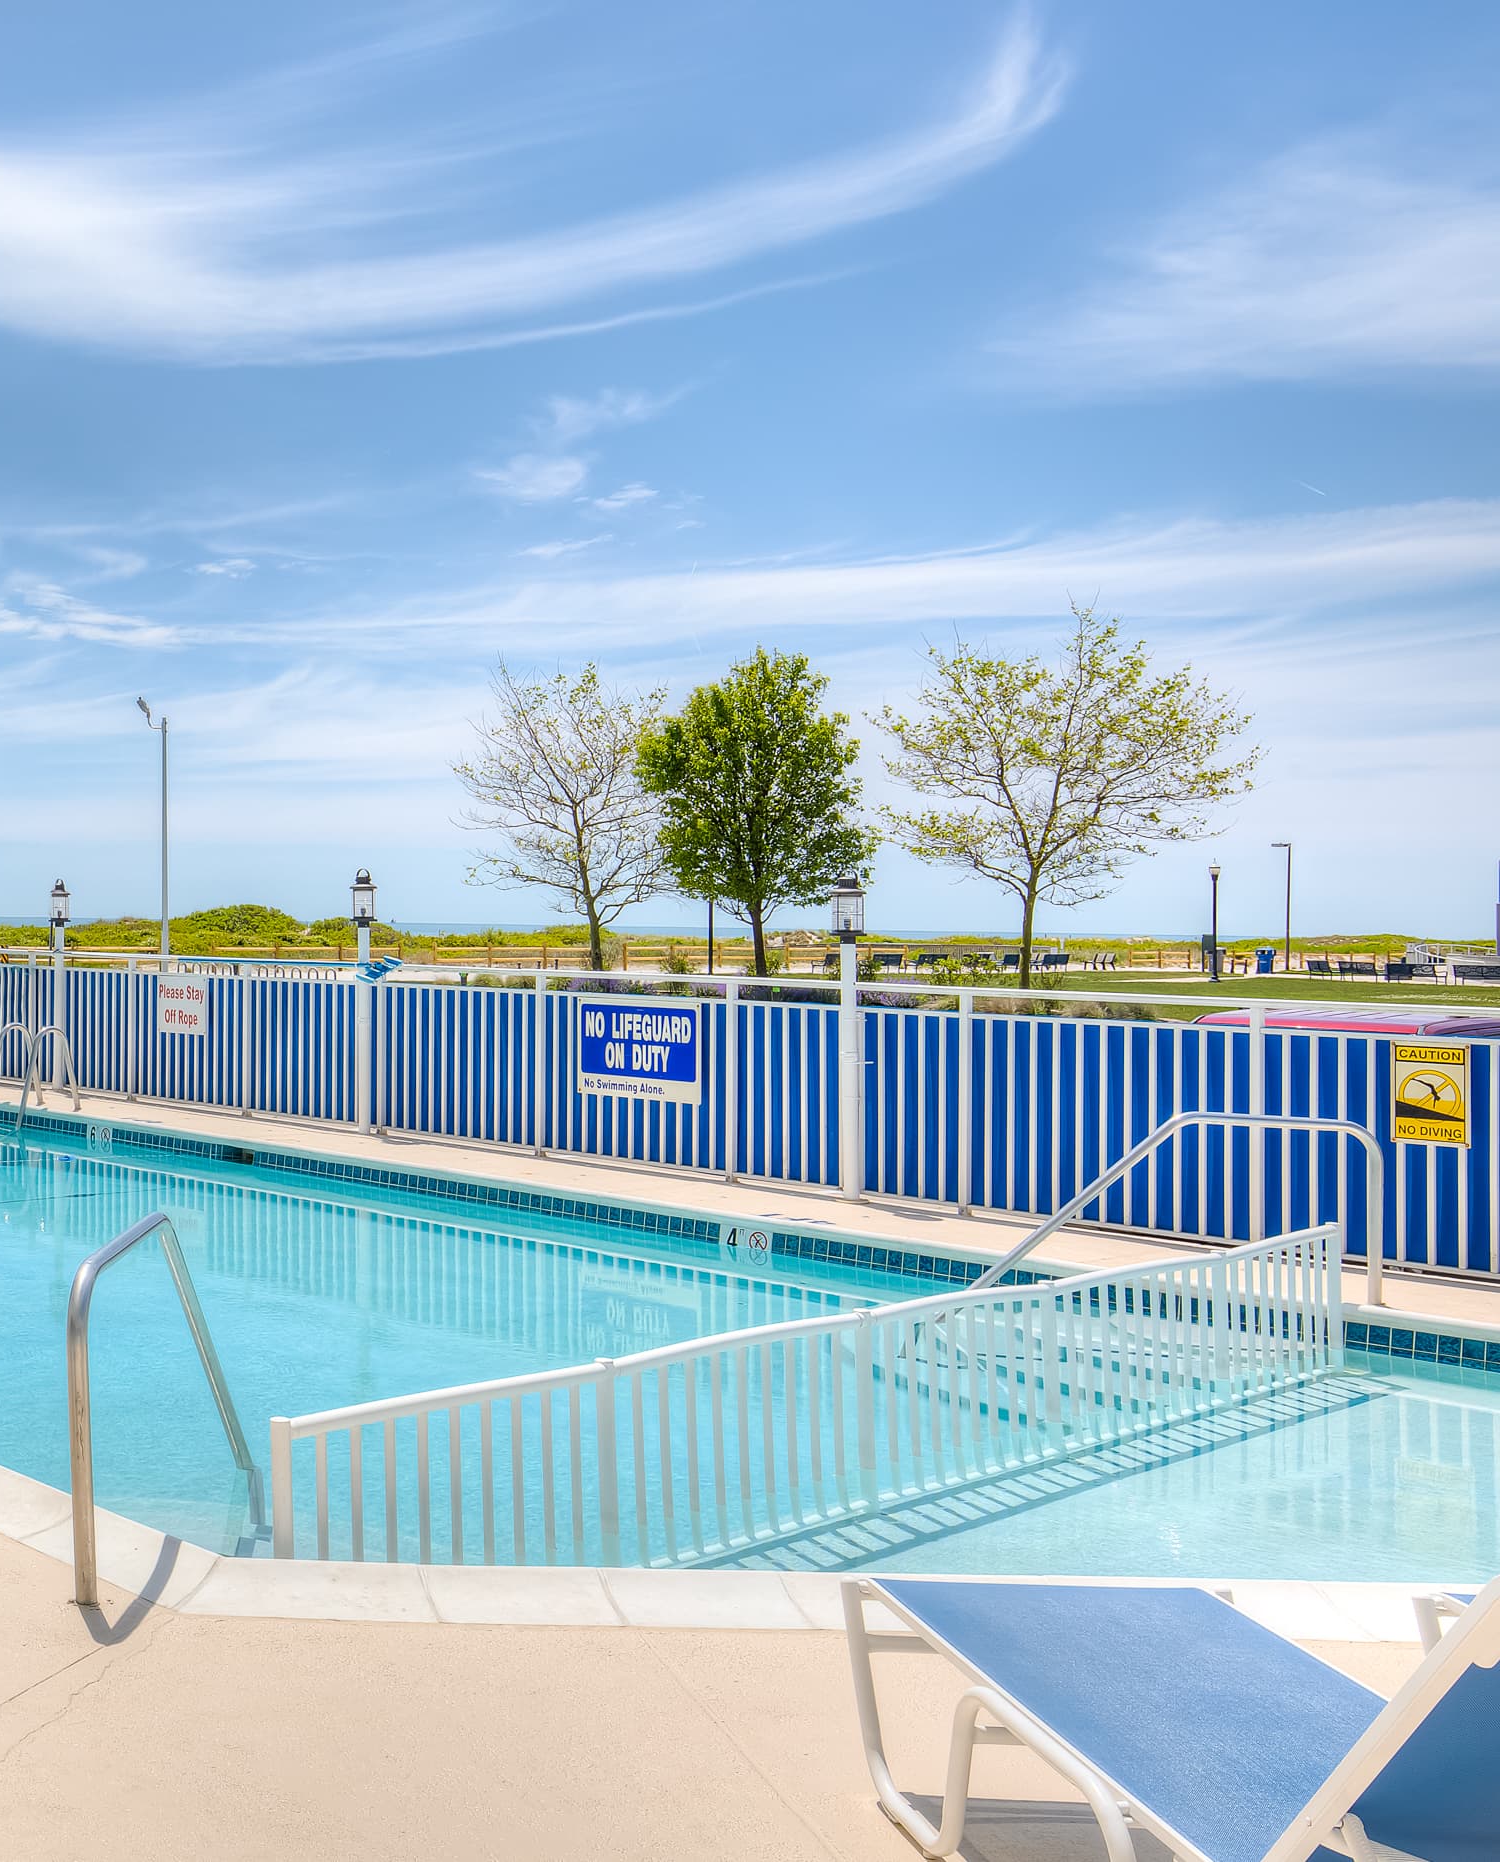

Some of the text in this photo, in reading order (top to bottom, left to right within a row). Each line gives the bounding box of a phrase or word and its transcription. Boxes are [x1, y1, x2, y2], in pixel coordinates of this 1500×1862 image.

[159, 984, 204, 1004] Please Stay
[164, 1009, 198, 1028] Off Rope
[585, 1010, 692, 1044] NO LIFEGUARD
[604, 1041, 671, 1073] ON DUTY
[1399, 1049, 1461, 1061] CAUTION
[584, 1078, 665, 1095] No Swimming Alone.
[1398, 1125, 1462, 1139] NO DIVING
[727, 1228, 738, 1247] 4
